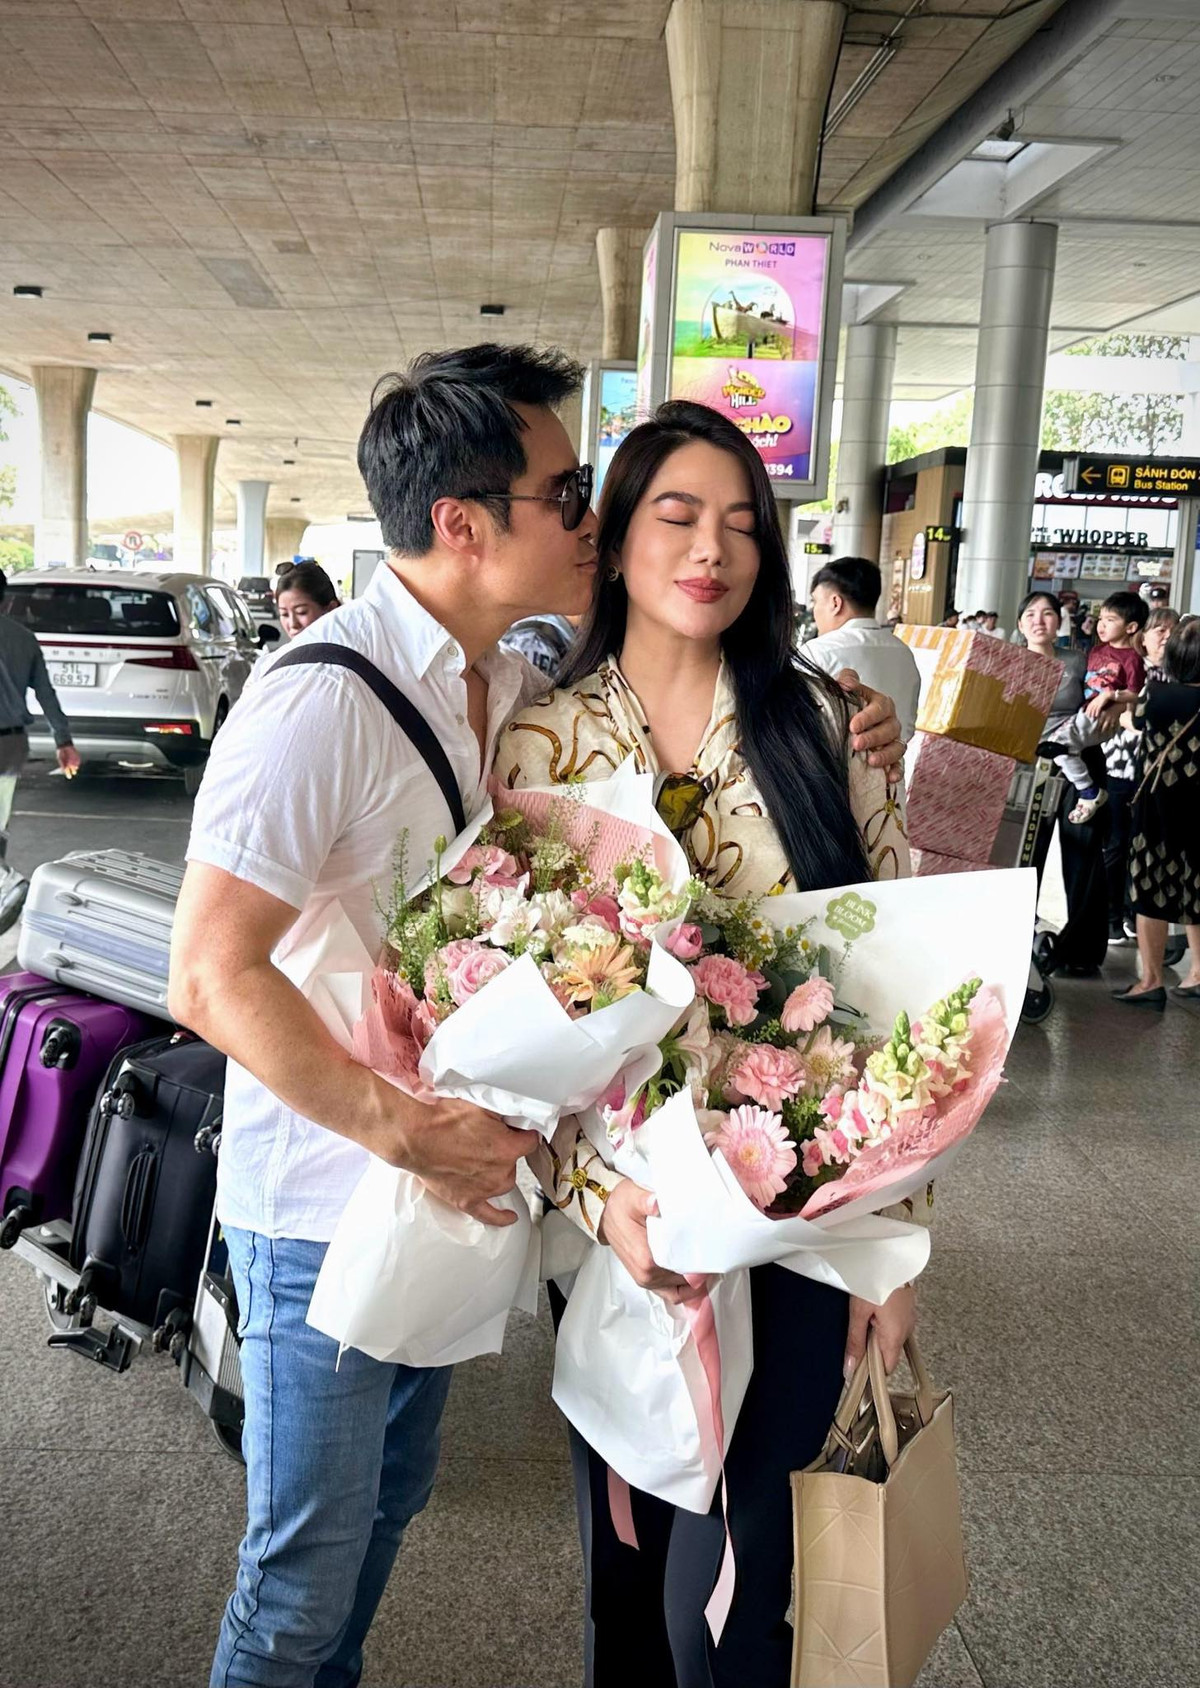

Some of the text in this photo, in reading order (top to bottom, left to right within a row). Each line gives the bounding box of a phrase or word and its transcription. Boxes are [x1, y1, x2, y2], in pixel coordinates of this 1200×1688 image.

[725, 259, 750, 267] PHAN
[1170, 467, 1196, 480] ĐÓN
[1134, 479, 1189, 491] Bus Station
[927, 527, 944, 541] 14
[805, 543, 818, 554] 15
[1022, 793, 1042, 862] GOLDSUN
